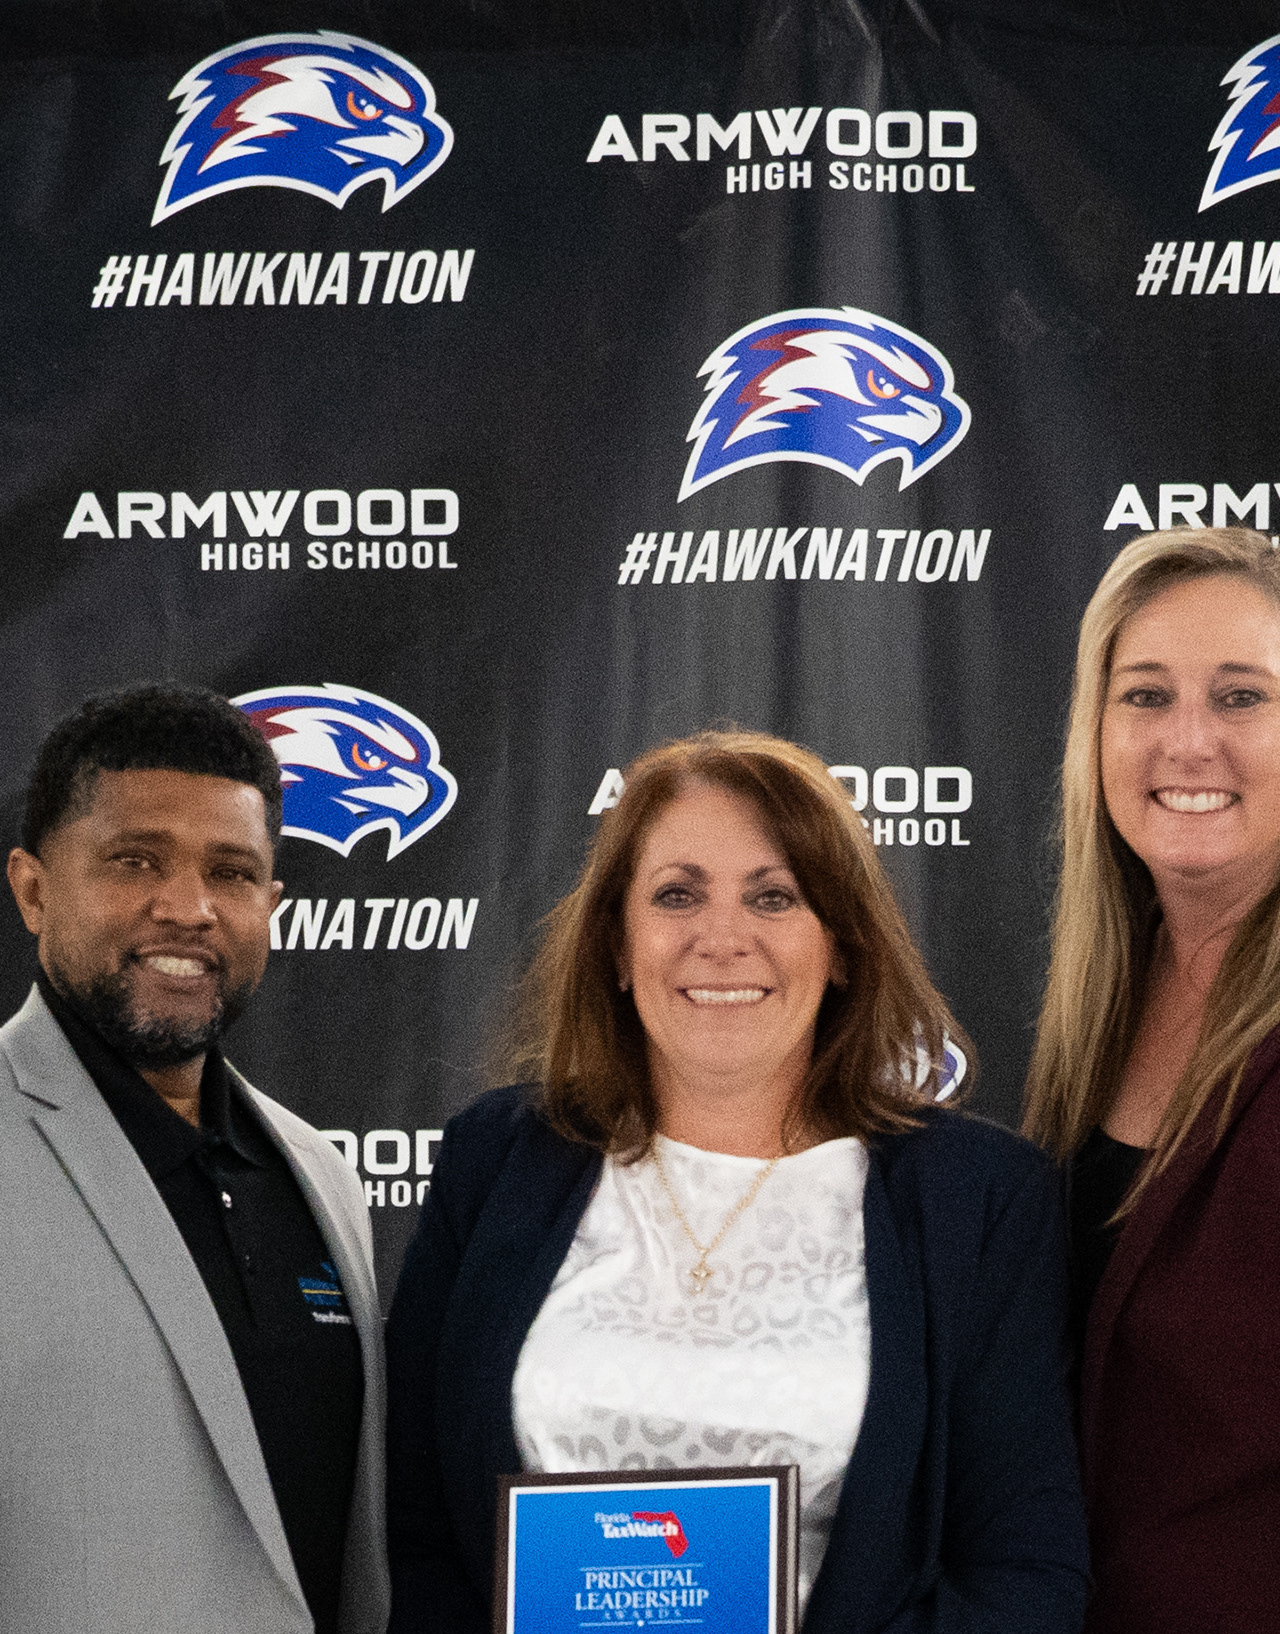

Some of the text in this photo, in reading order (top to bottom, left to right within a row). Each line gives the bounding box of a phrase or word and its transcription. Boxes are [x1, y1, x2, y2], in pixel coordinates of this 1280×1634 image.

[587, 107, 976, 162] ARMWOOD
[727, 161, 974, 193] HIGH SCHOOL
[92, 250, 474, 307] #HAWKNATION
[64, 489, 459, 538] ARMWOOD
[202, 542, 457, 570] HIGH SCHOOL
[618, 527, 991, 585] #HAWKNATION
[861, 818, 970, 847] HOOL
[585, 1569, 698, 1590] PRINCIPAL
[575, 1589, 709, 1611] LEADERSHIP
